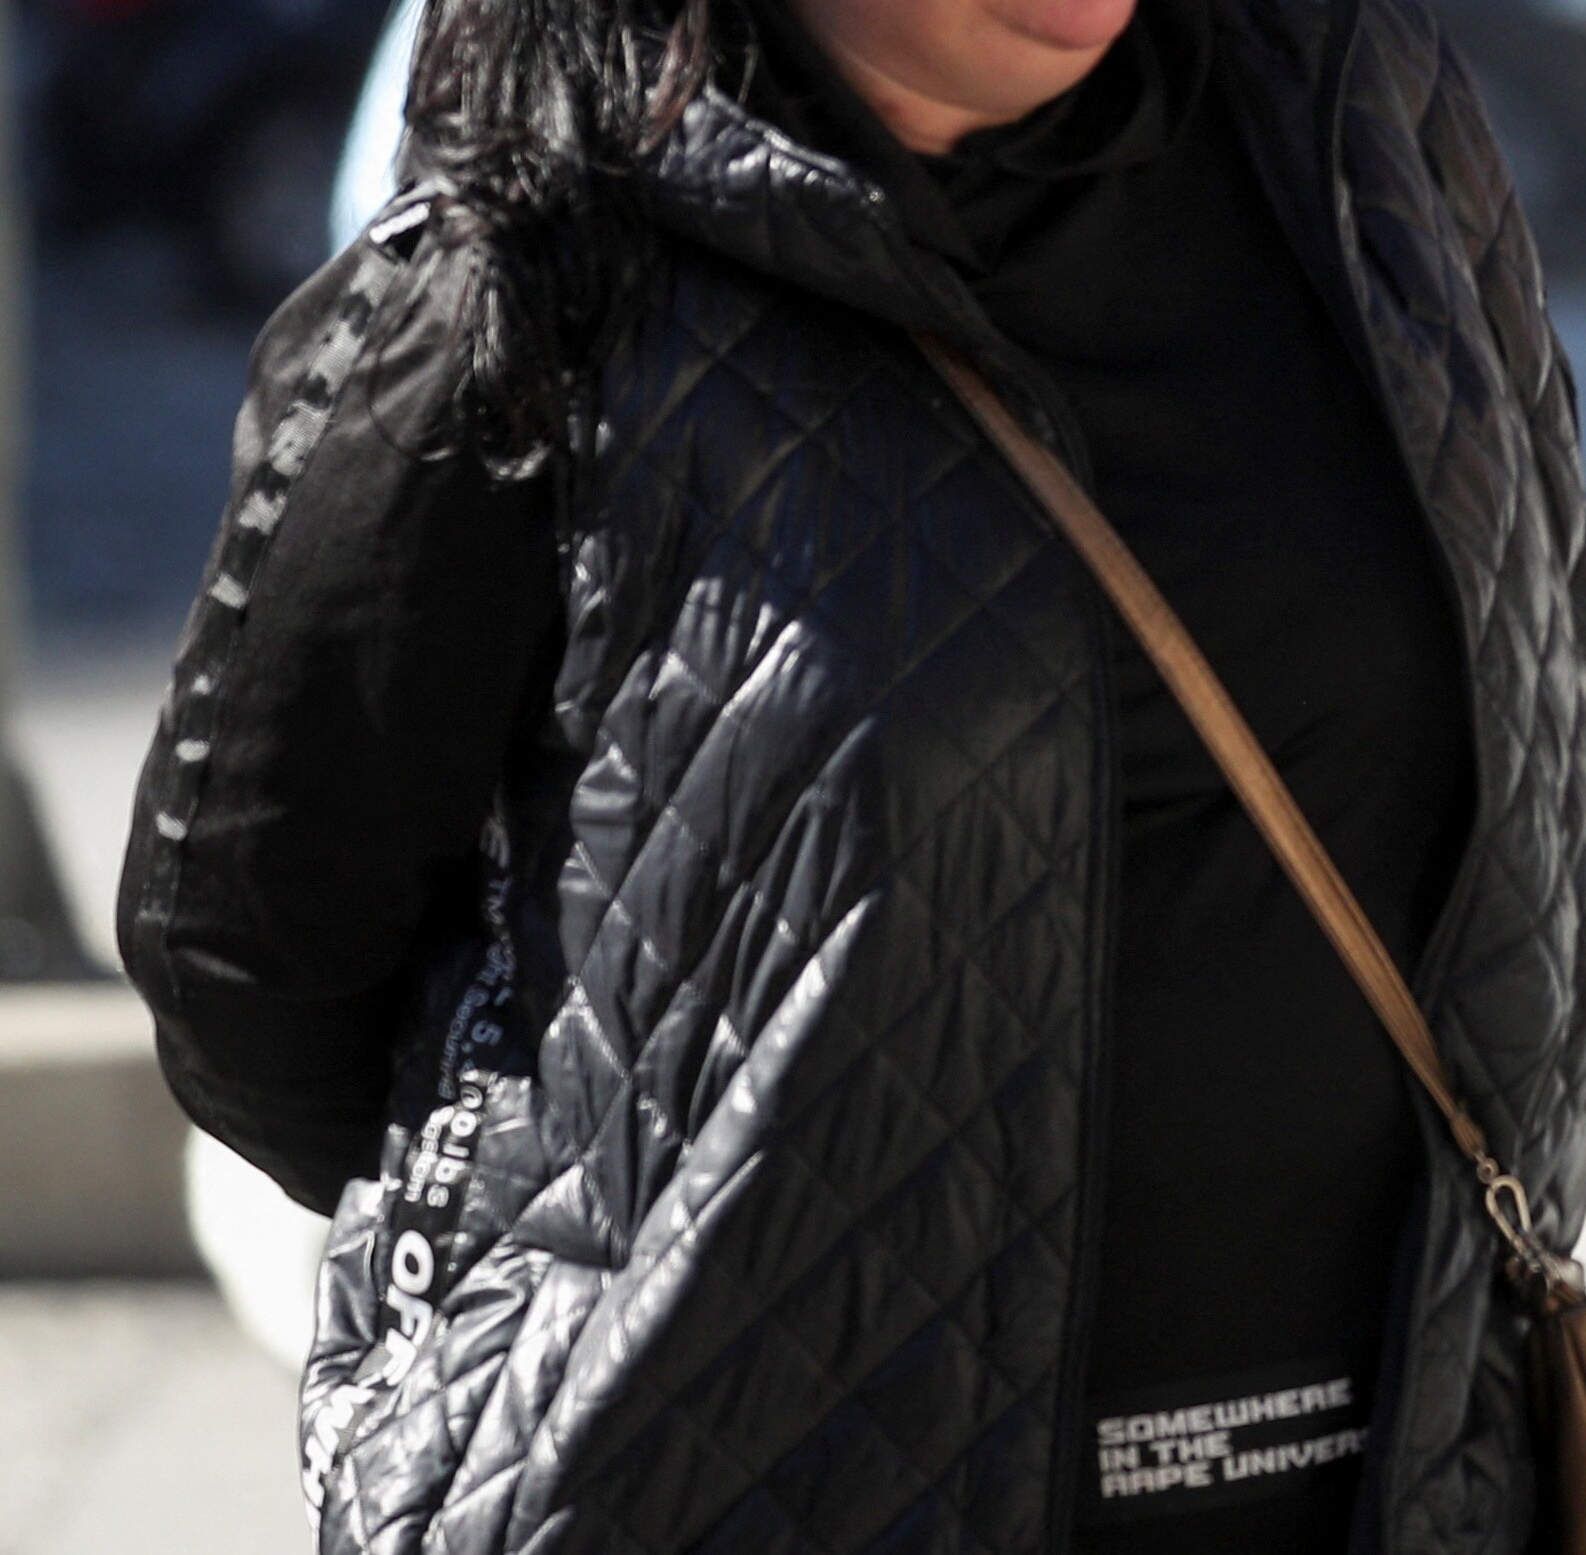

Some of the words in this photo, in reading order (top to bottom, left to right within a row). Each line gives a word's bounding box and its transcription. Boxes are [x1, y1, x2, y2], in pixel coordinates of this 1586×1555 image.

[1097, 1377, 1352, 1445] SOMEWHERE
[1099, 1444, 1140, 1472] IN
[1150, 1430, 1231, 1466] THE
[1222, 1427, 1368, 1482] UNIVER
